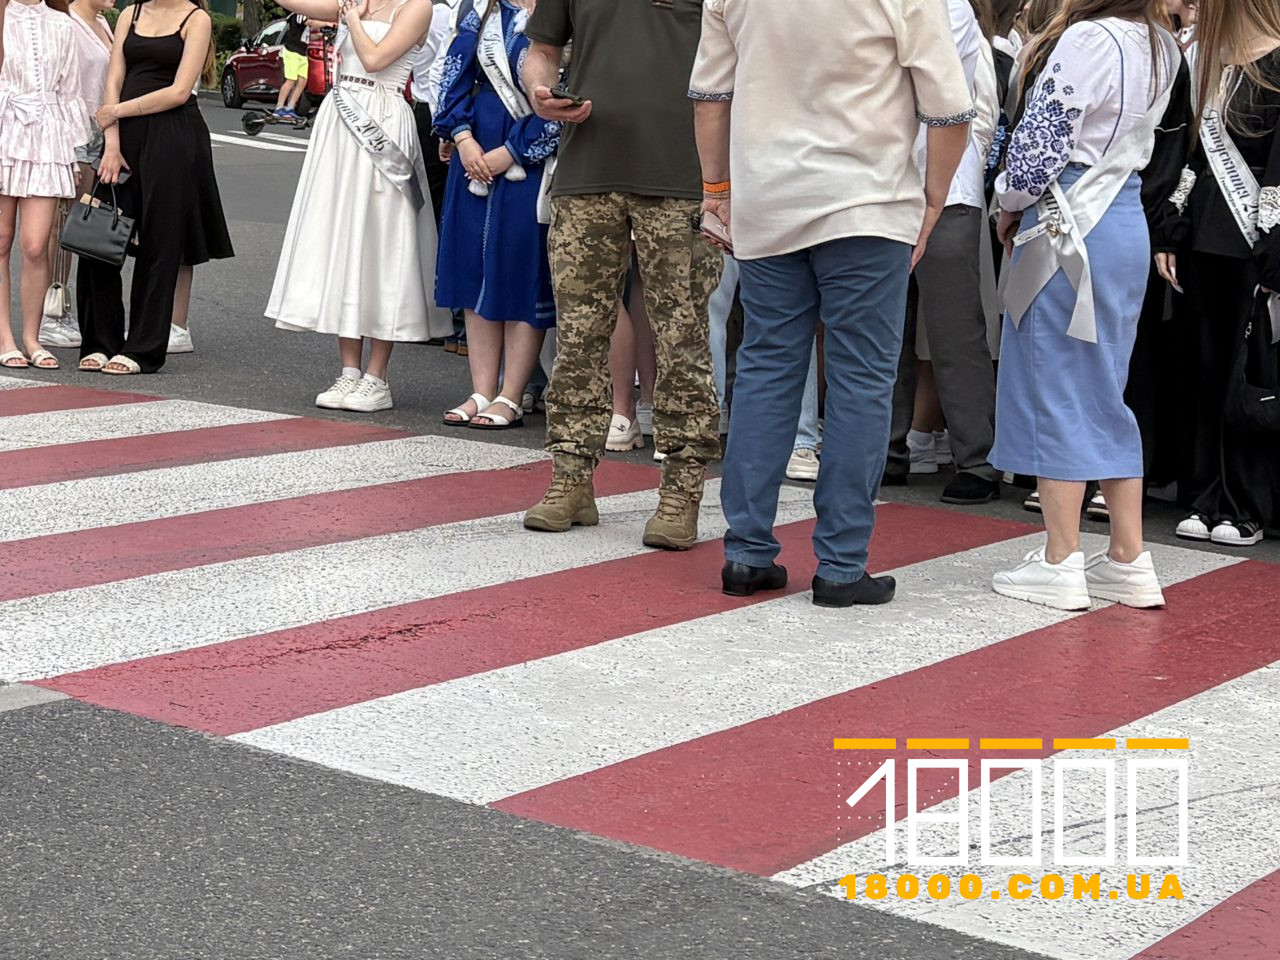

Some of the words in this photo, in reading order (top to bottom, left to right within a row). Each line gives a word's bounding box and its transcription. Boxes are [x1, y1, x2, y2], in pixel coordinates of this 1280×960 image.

[355, 119, 391, 151] 2026
[1202, 106, 1251, 200] Випускниця
[1242, 200, 1260, 222] 20
